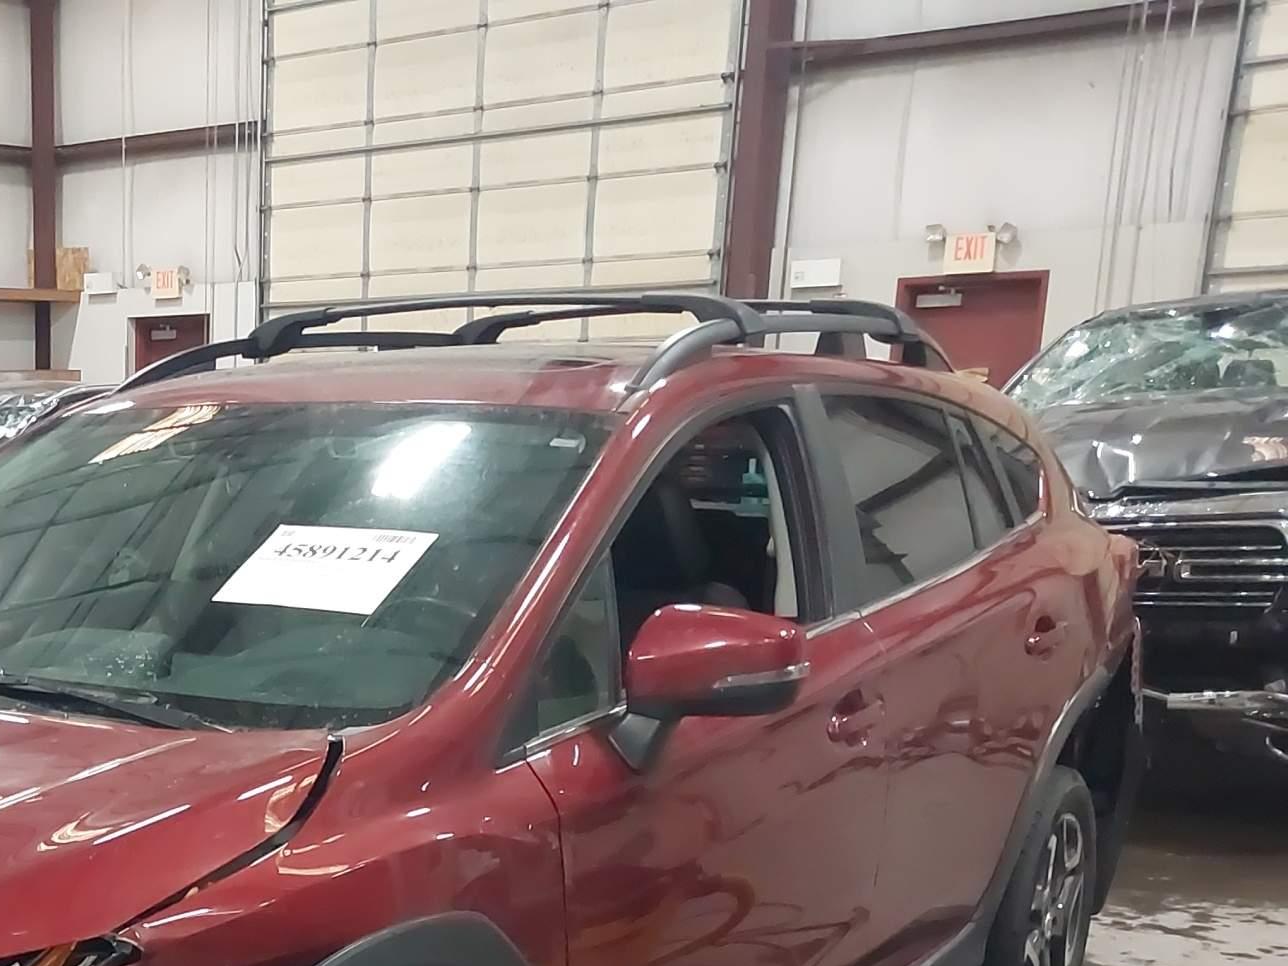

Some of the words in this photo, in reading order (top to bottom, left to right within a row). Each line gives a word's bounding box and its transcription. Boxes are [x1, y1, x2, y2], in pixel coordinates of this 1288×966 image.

[953, 235, 988, 261] EXIT
[156, 270, 175, 289] EXIT
[274, 543, 401, 563] 45891214
